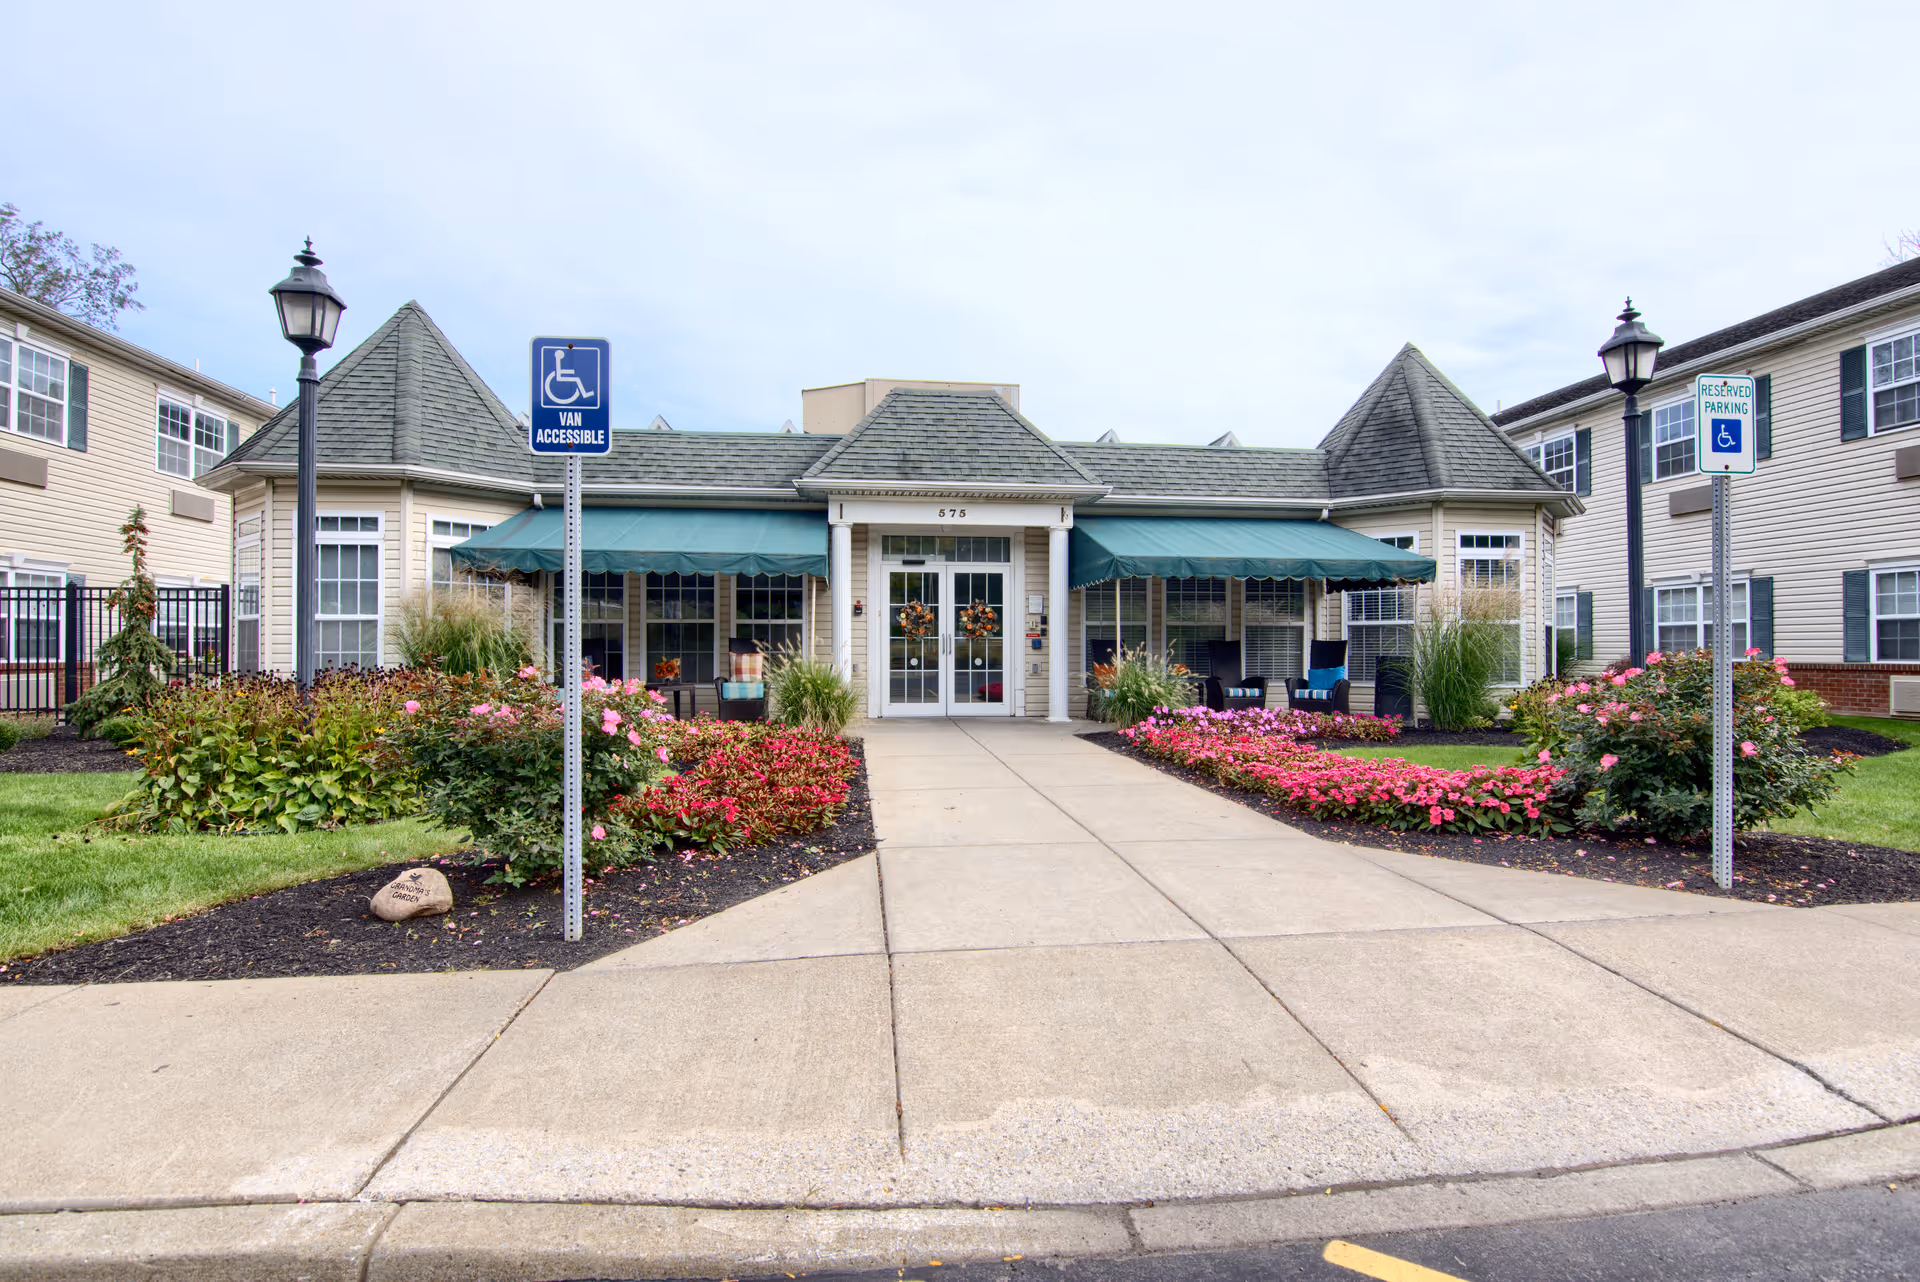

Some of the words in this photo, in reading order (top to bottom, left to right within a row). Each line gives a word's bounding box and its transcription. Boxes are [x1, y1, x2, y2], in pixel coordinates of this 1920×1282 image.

[1702, 384, 1752, 398] RESERVED
[1704, 402, 1748, 414] PARKING
[559, 412, 582, 426] VAN
[536, 428, 604, 444] ACCESSIBLE
[938, 508, 966, 518] 575
[390, 882, 430, 896] GRANDMA'S
[392, 892, 420, 904] GARDEN
